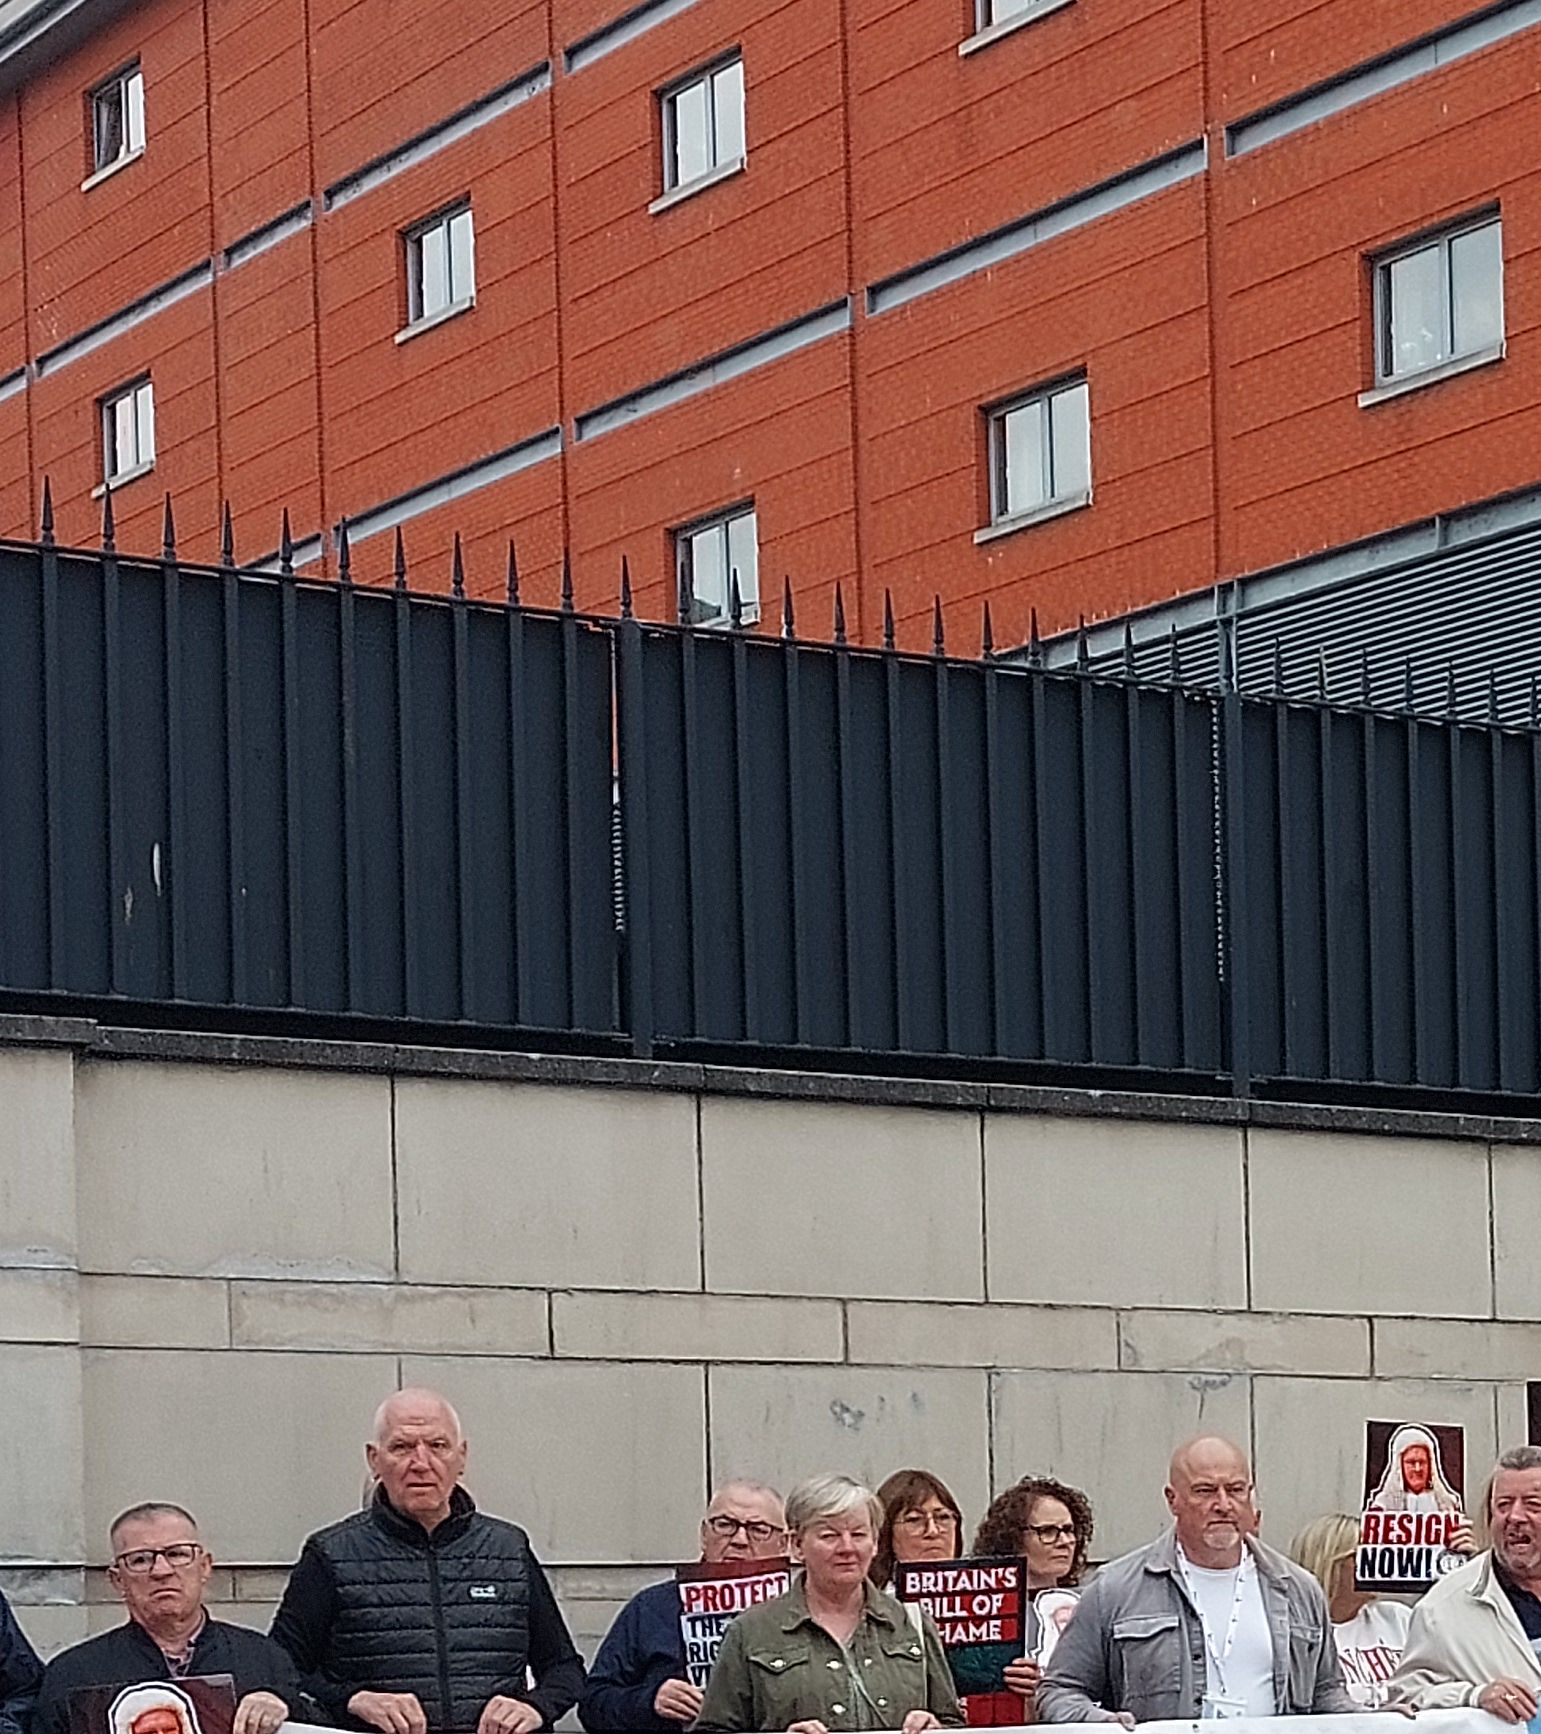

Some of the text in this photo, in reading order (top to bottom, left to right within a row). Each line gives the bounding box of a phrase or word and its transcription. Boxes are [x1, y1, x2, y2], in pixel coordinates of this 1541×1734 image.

[1359, 1547, 1433, 1579] NOW!
[684, 1574, 787, 1613] PROTECT
[905, 1567, 1018, 1594] BRITAIN'S
[972, 1594, 1004, 1616] OF
[937, 1620, 1002, 1644] HAME
